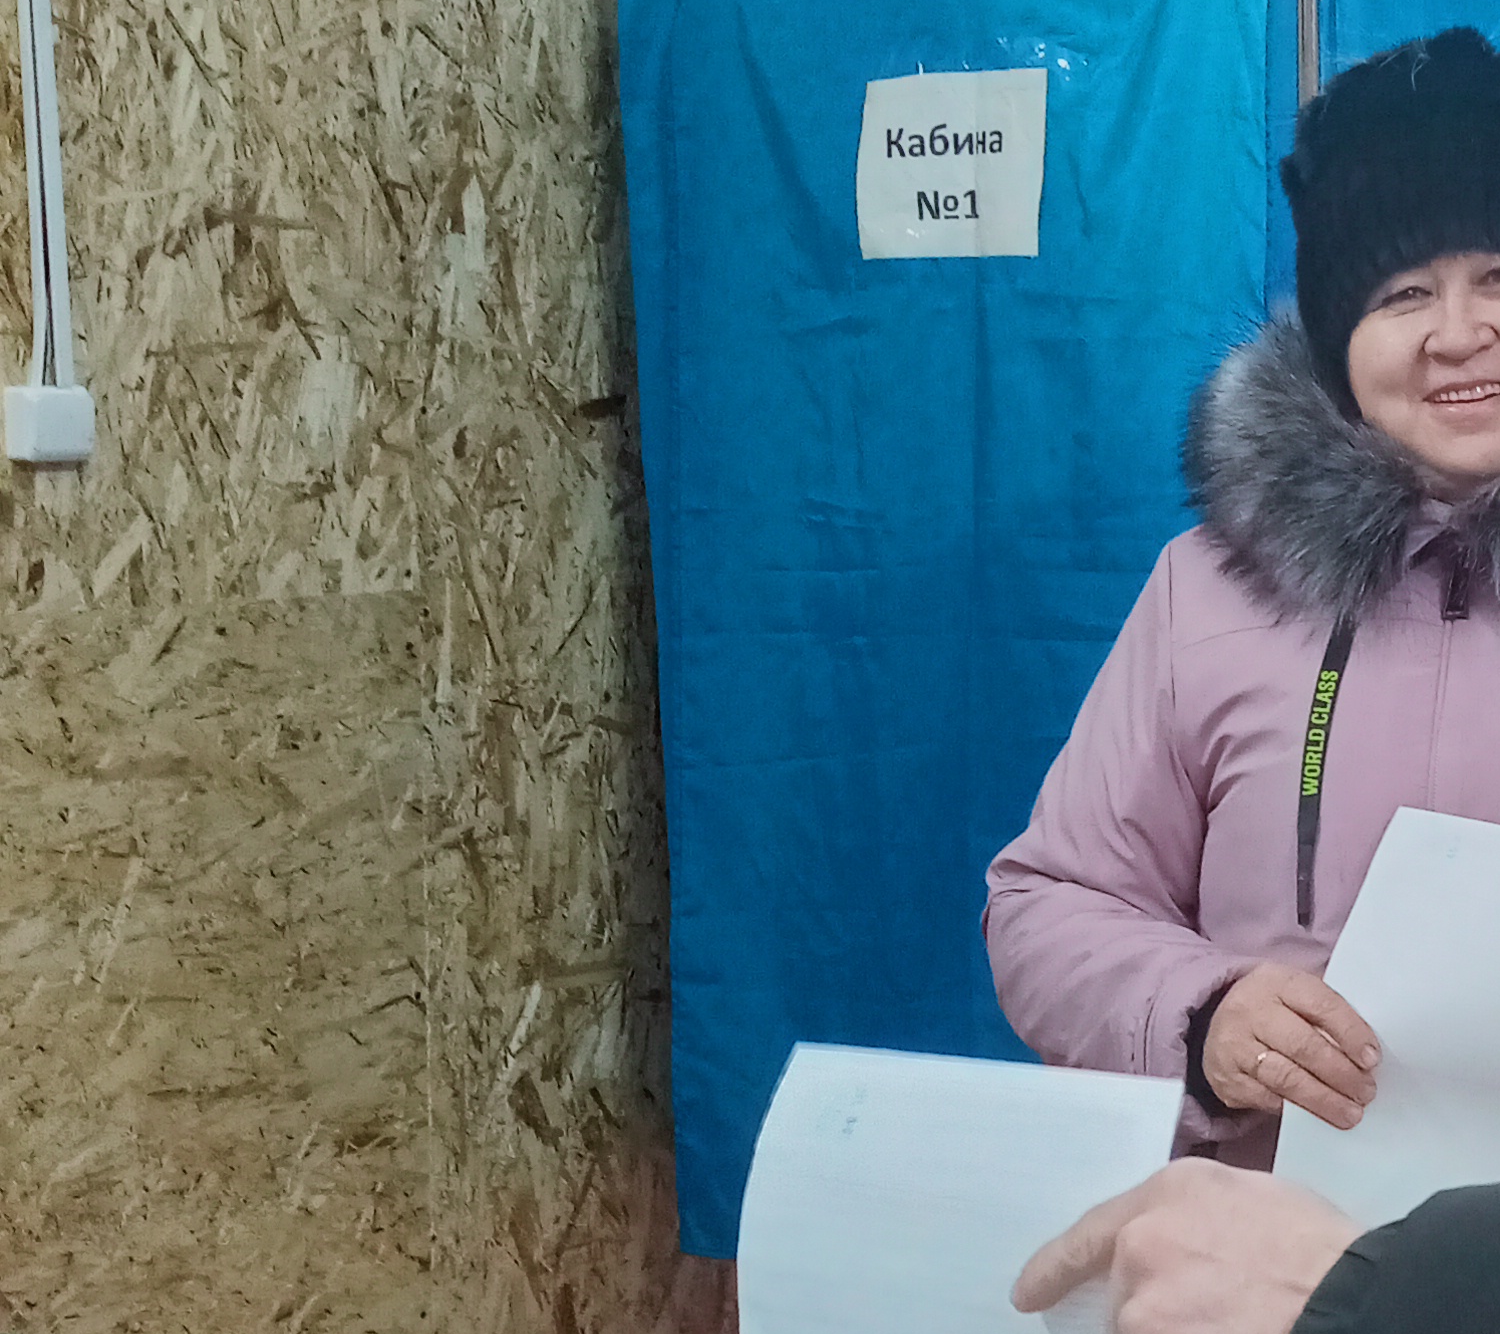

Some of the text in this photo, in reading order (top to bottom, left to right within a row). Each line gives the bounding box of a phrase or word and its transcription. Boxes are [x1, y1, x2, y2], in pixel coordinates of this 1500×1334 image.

[886, 123, 1004, 158] Кабина
[916, 189, 980, 221] №1
[1302, 670, 1339, 796] WORLD CLASS
